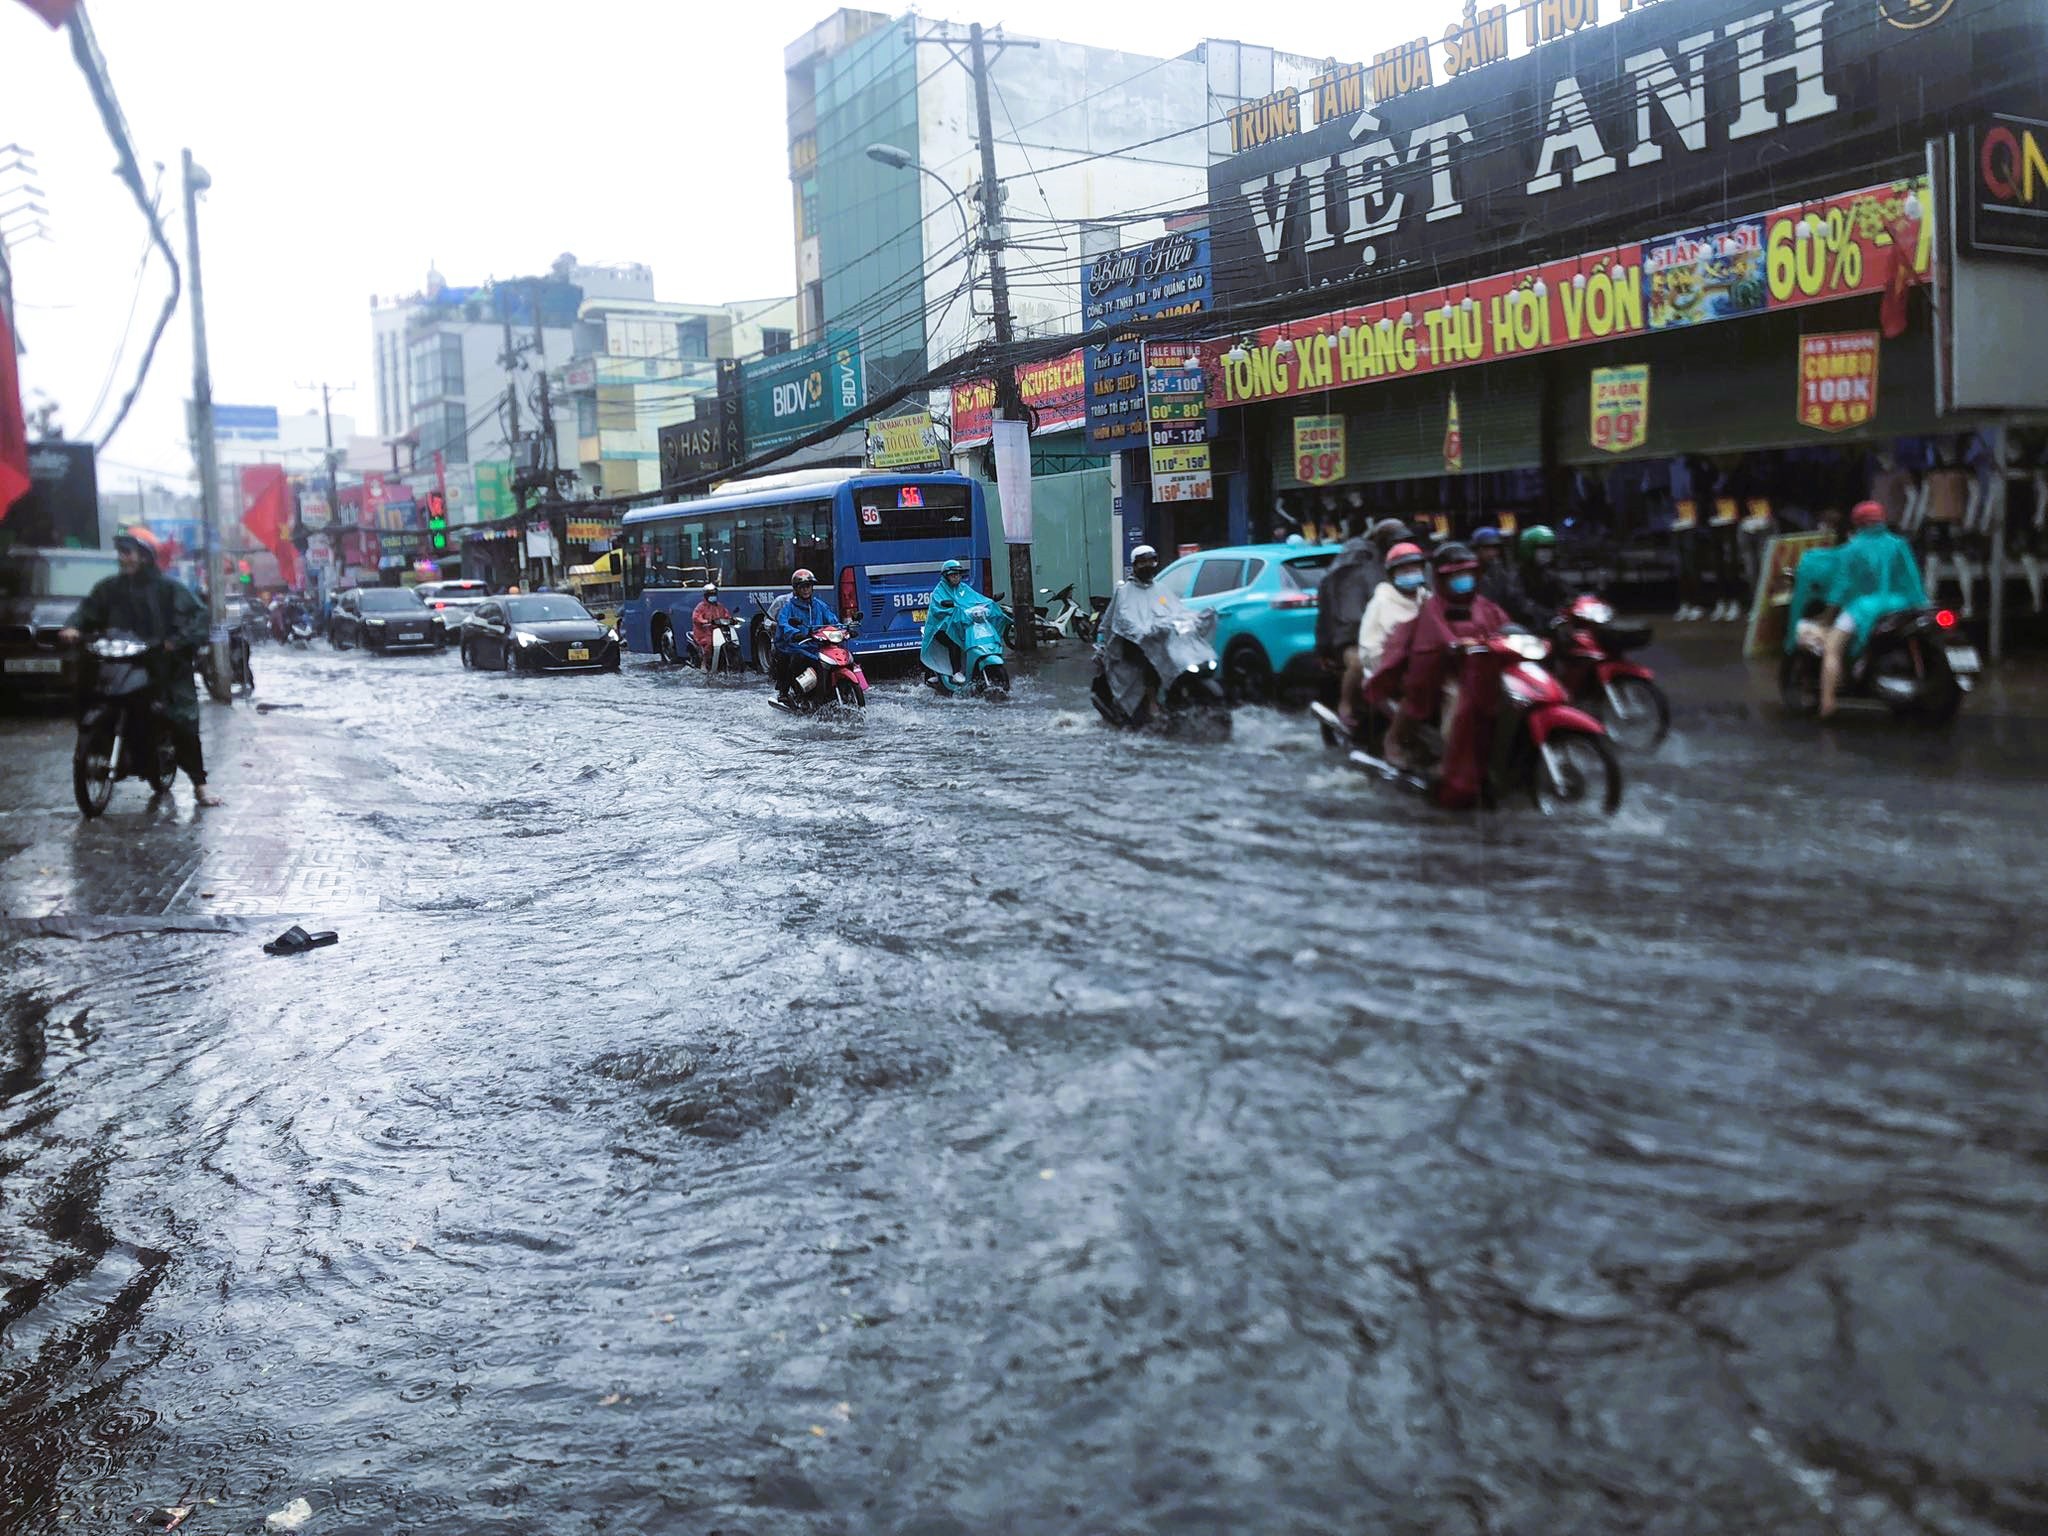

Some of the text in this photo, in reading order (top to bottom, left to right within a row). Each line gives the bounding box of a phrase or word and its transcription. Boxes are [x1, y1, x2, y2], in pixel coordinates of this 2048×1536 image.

[1227, 86, 1299, 153] TRUNG
[1309, 56, 1364, 124] TÂM
[1373, 37, 1433, 104] MUA
[1240, 0, 1838, 266] VIỆT ANH
[1767, 207, 1863, 301] 60%
[1105, 300, 1113, 314] TY
[1136, 291, 1146, 304] TM
[1152, 287, 1162, 301] DV
[1163, 278, 1186, 297] QUẢNG
[1339, 314, 1417, 383] HÀNG
[1424, 299, 1482, 366] THU
[1559, 255, 1643, 341] VỐN
[772, 378, 809, 418] BIDV
[840, 364, 857, 407] BIDV
[1805, 377, 1869, 402] 100K
[862, 508, 878, 523] 56
[901, 486, 920, 507] 56
